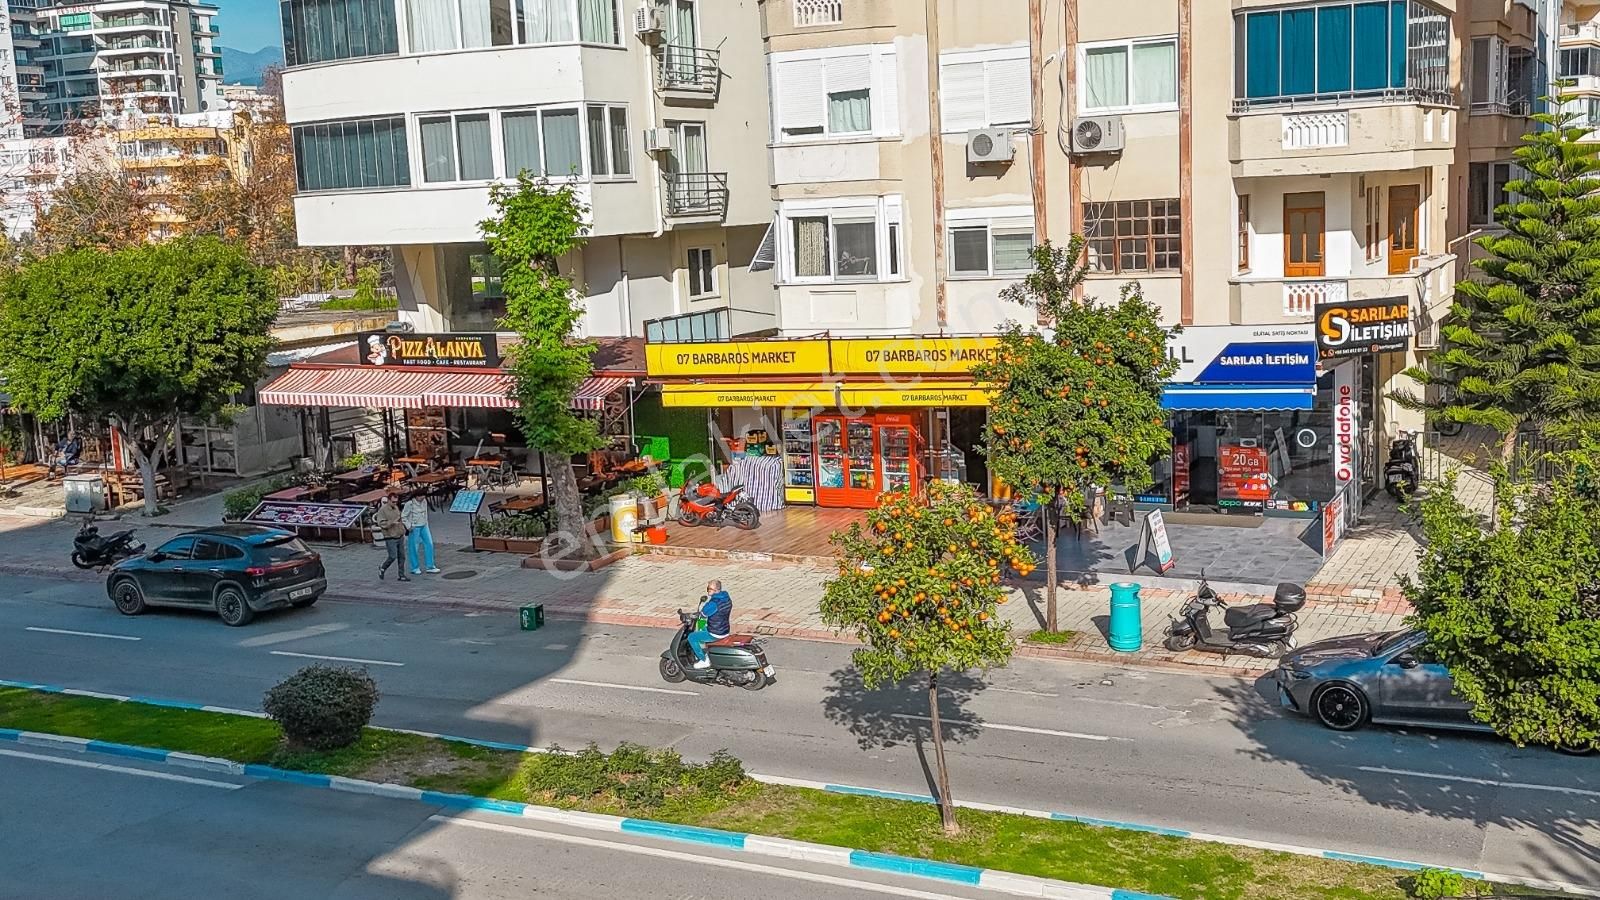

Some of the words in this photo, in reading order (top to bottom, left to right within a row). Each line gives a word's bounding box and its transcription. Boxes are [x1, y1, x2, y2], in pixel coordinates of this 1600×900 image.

[1350, 304, 1409, 322] SARILAR
[1350, 320, 1408, 341] İLETİŞİM
[676, 353, 689, 365] 07
[693, 352, 749, 365] BARBAROS
[752, 351, 796, 364] MARKET
[866, 350, 880, 362] 07
[883, 349, 947, 362] BARBAROS
[950, 348, 1000, 361] MARKET
[1220, 355, 1263, 366] SARILAR
[1265, 352, 1309, 366] İLETİŞİM
[1336, 385, 1351, 465] vodafone
[1232, 453, 1247, 466] 20
[1247, 458, 1259, 466] GB
